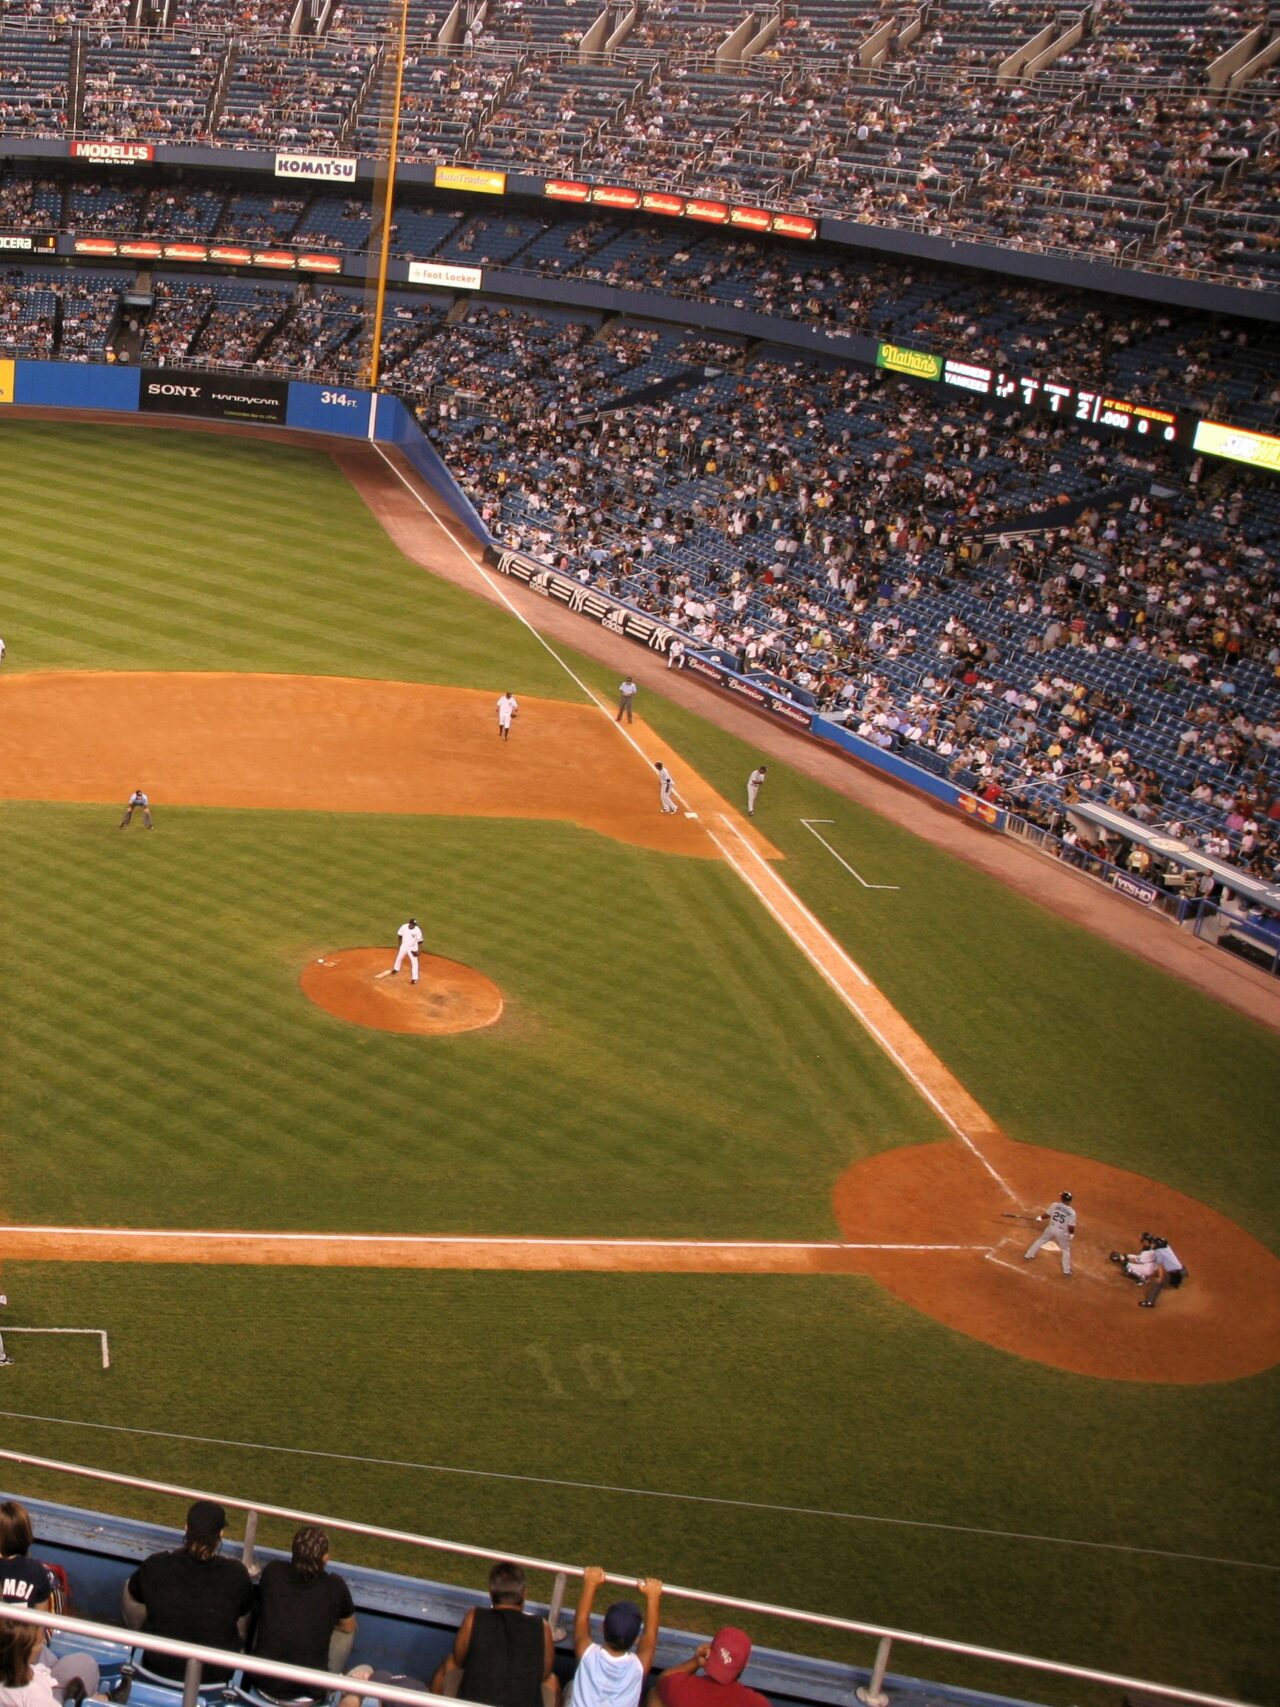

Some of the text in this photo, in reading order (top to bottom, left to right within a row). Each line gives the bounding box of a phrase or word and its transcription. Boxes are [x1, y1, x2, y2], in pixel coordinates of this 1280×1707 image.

[76, 143, 148, 160] MODELL'S
[277, 159, 354, 177] KOMATSU
[882, 344, 937, 373] Nathan's
[148, 384, 201, 398] SONY
[320, 391, 346, 407] 314
[1078, 392, 1095, 402] OUT
[1023, 388, 1090, 419] 1 1 2
[529, 581, 548, 597] adidas
[602, 618, 624, 635] adidas
[688, 656, 721, 680] Budweiser
[728, 677, 764, 701] Budweiser
[772, 699, 810, 724] Budweiser
[1053, 1211, 1066, 1223] 25
